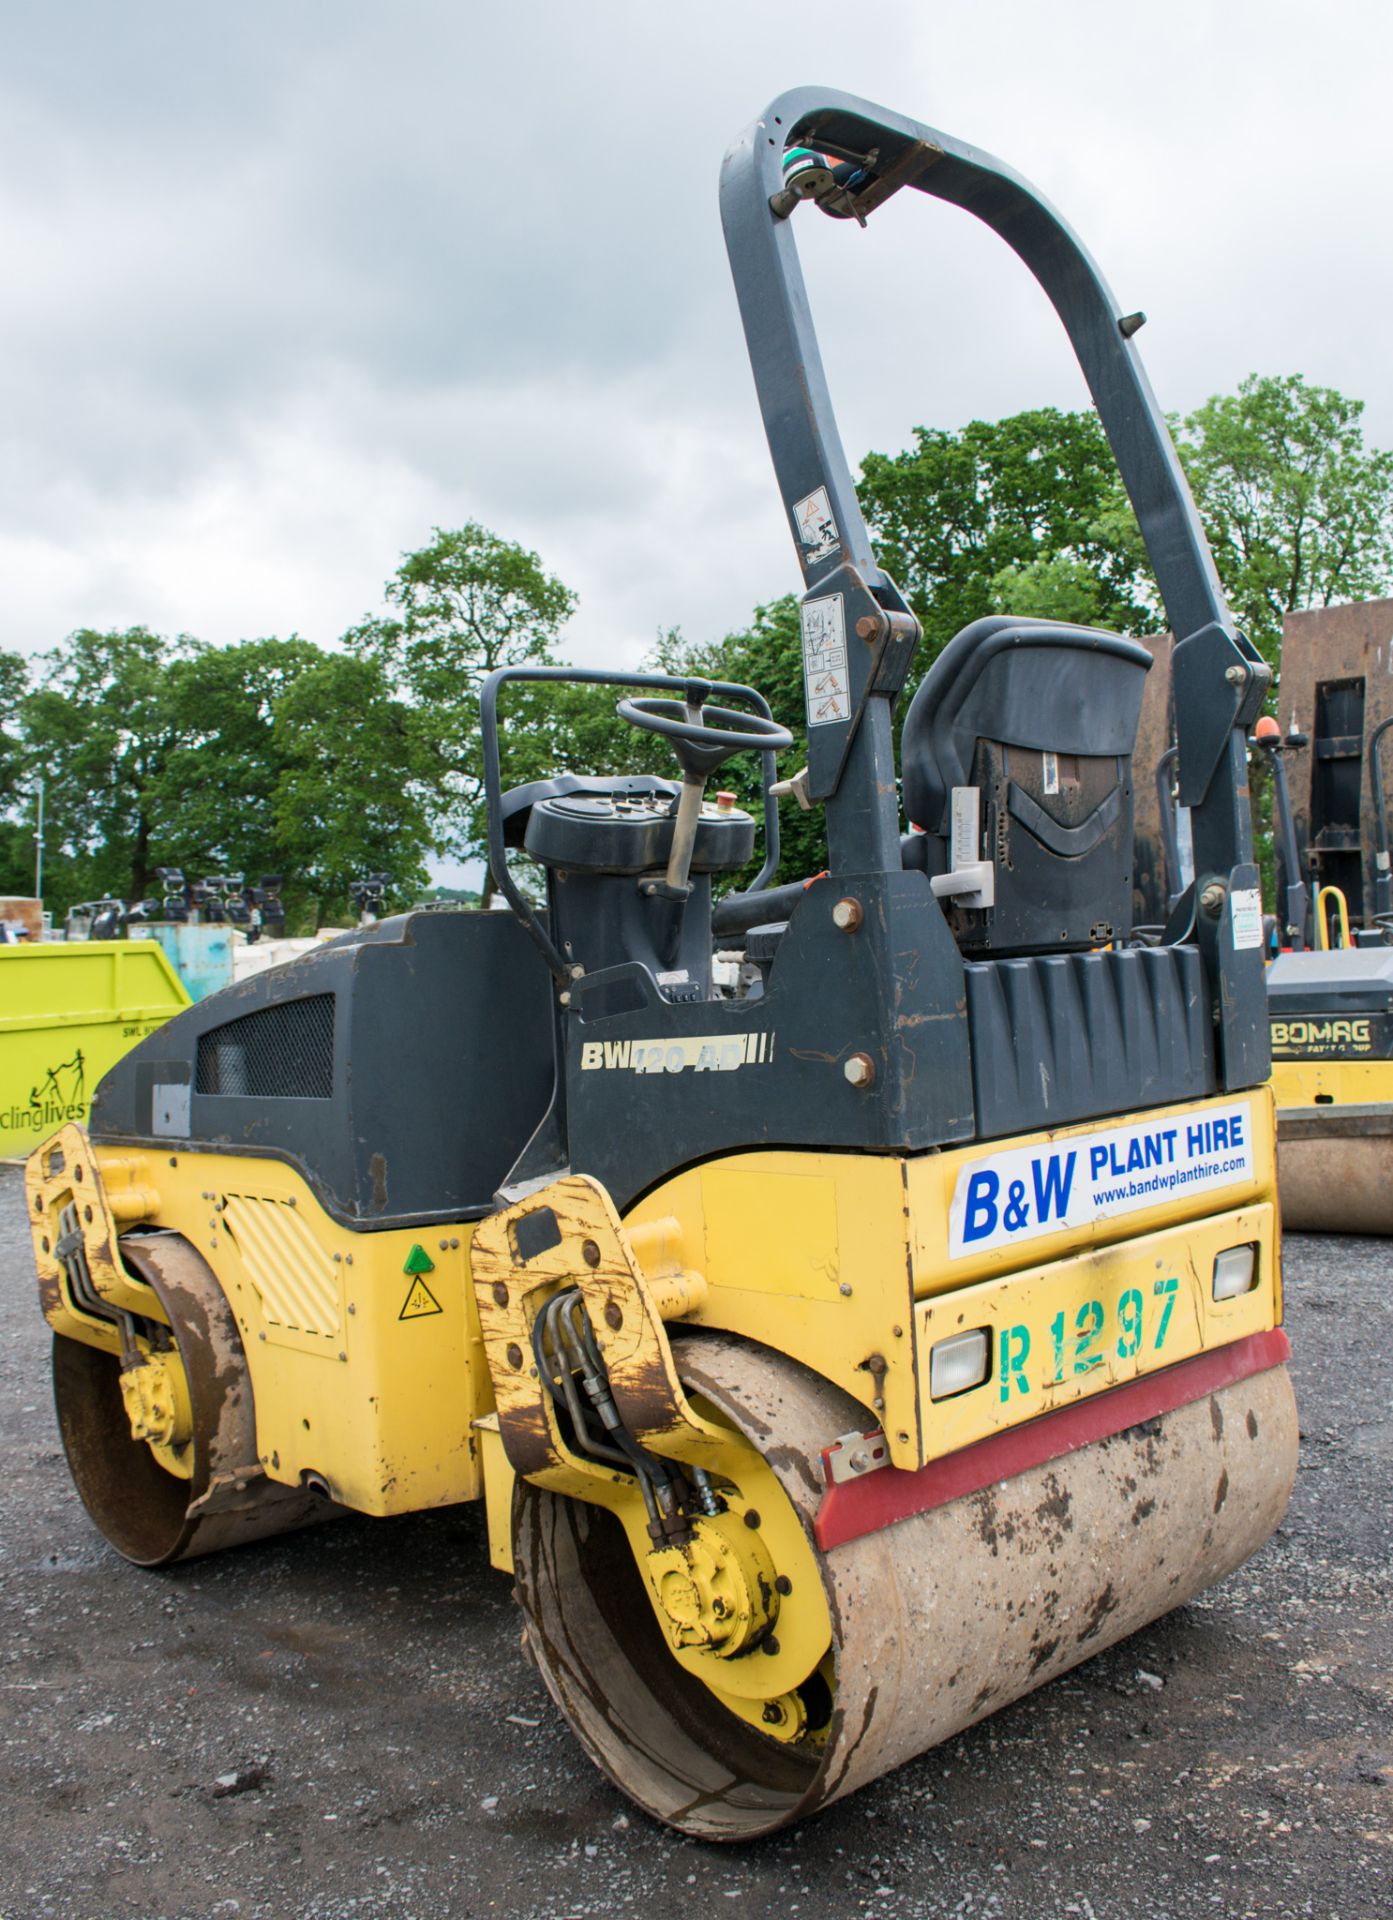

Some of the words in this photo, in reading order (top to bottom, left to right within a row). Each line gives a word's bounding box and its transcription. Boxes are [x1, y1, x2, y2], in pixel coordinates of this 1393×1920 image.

[1271, 1020, 1371, 1044] BOMAG
[1090, 1129, 1177, 1181] PLANT
[1187, 1115, 1244, 1158] HIRE
[963, 1151, 1077, 1243] B&W
[1093, 1157, 1246, 1206] www.bandwplanthire.com
